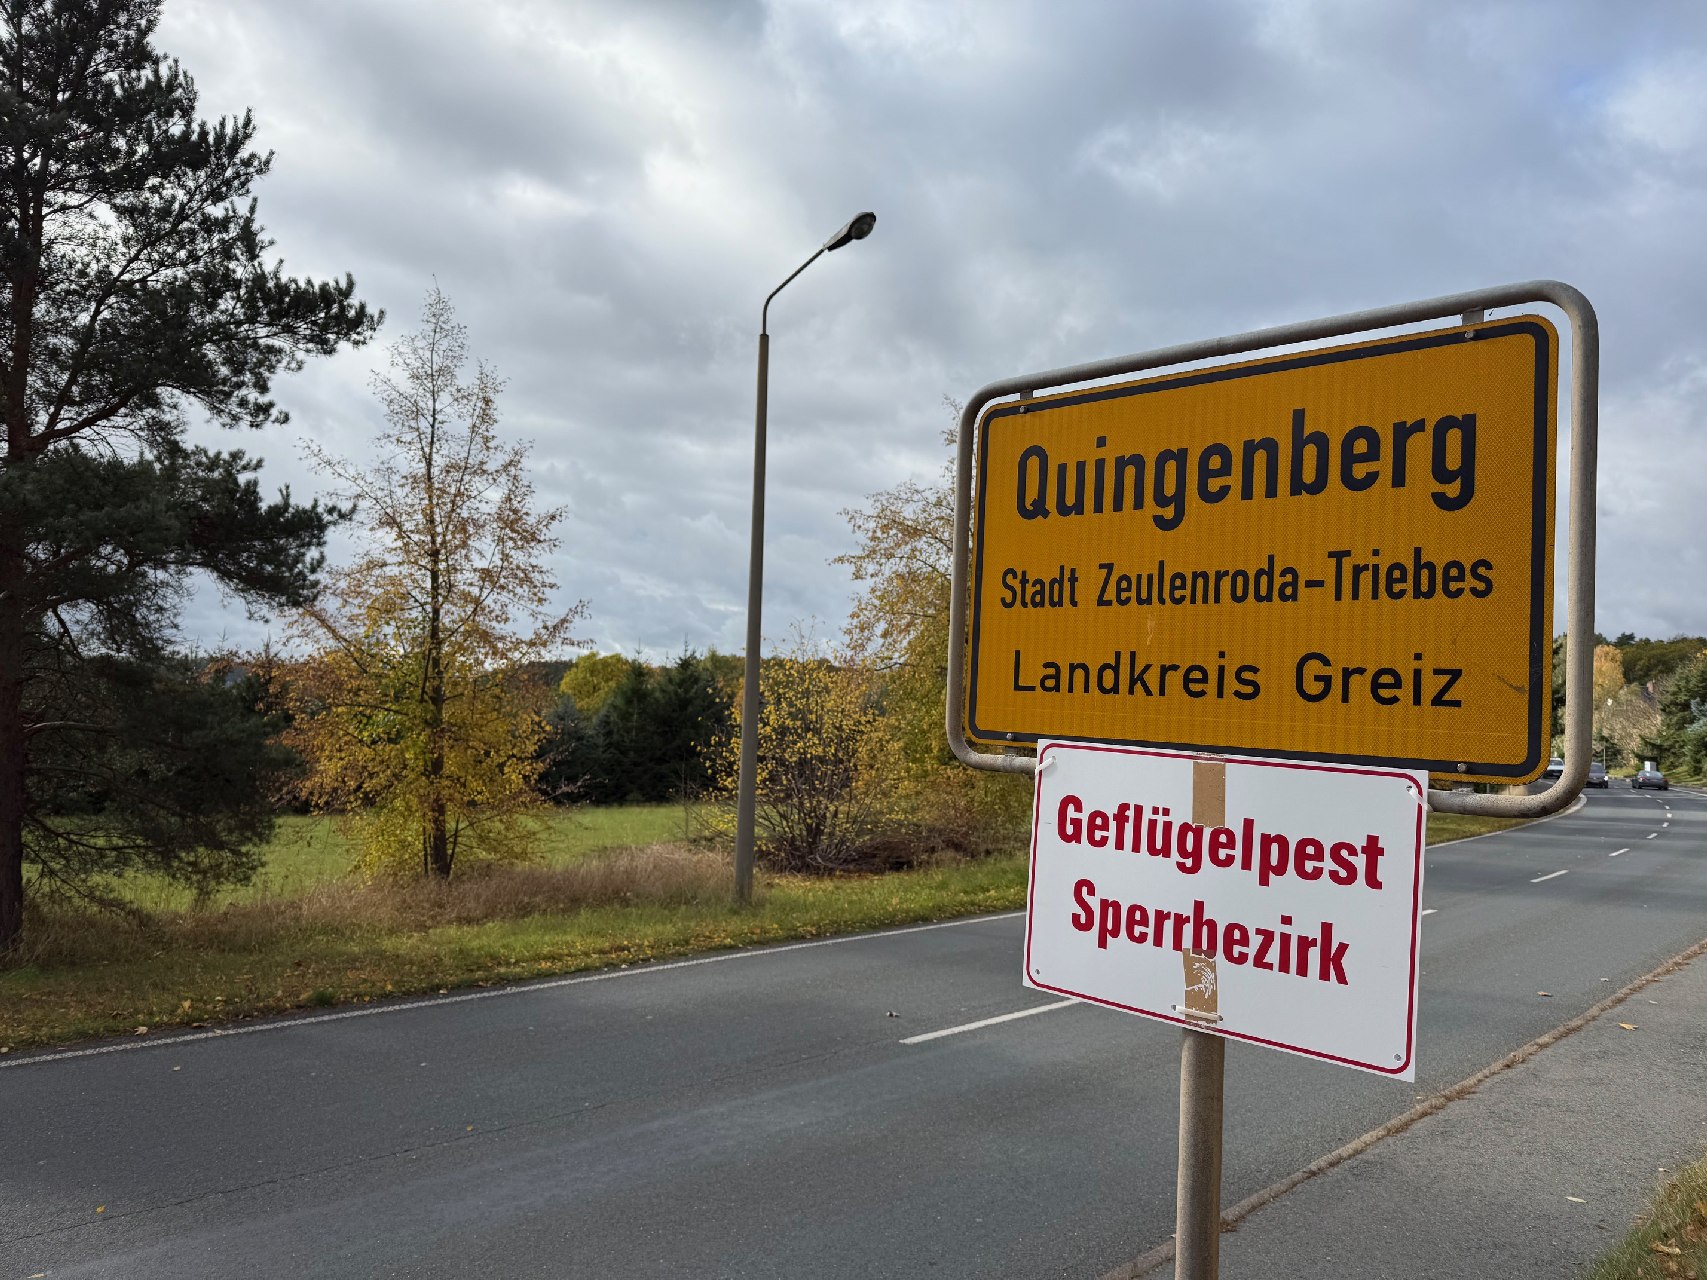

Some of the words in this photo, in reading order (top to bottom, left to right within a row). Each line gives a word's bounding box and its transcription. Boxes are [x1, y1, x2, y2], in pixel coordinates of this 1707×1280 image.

[1016, 408, 1477, 531] Quingenberg
[1000, 565, 1078, 609] Stadt
[1097, 547, 1494, 607] Zeulenroda-Triebes
[1013, 650, 1261, 700] Landkreis
[1295, 652, 1462, 707] Greiz
[1057, 794, 1384, 890] Geflügelpest
[1071, 878, 1349, 986] Sperrbezirk
